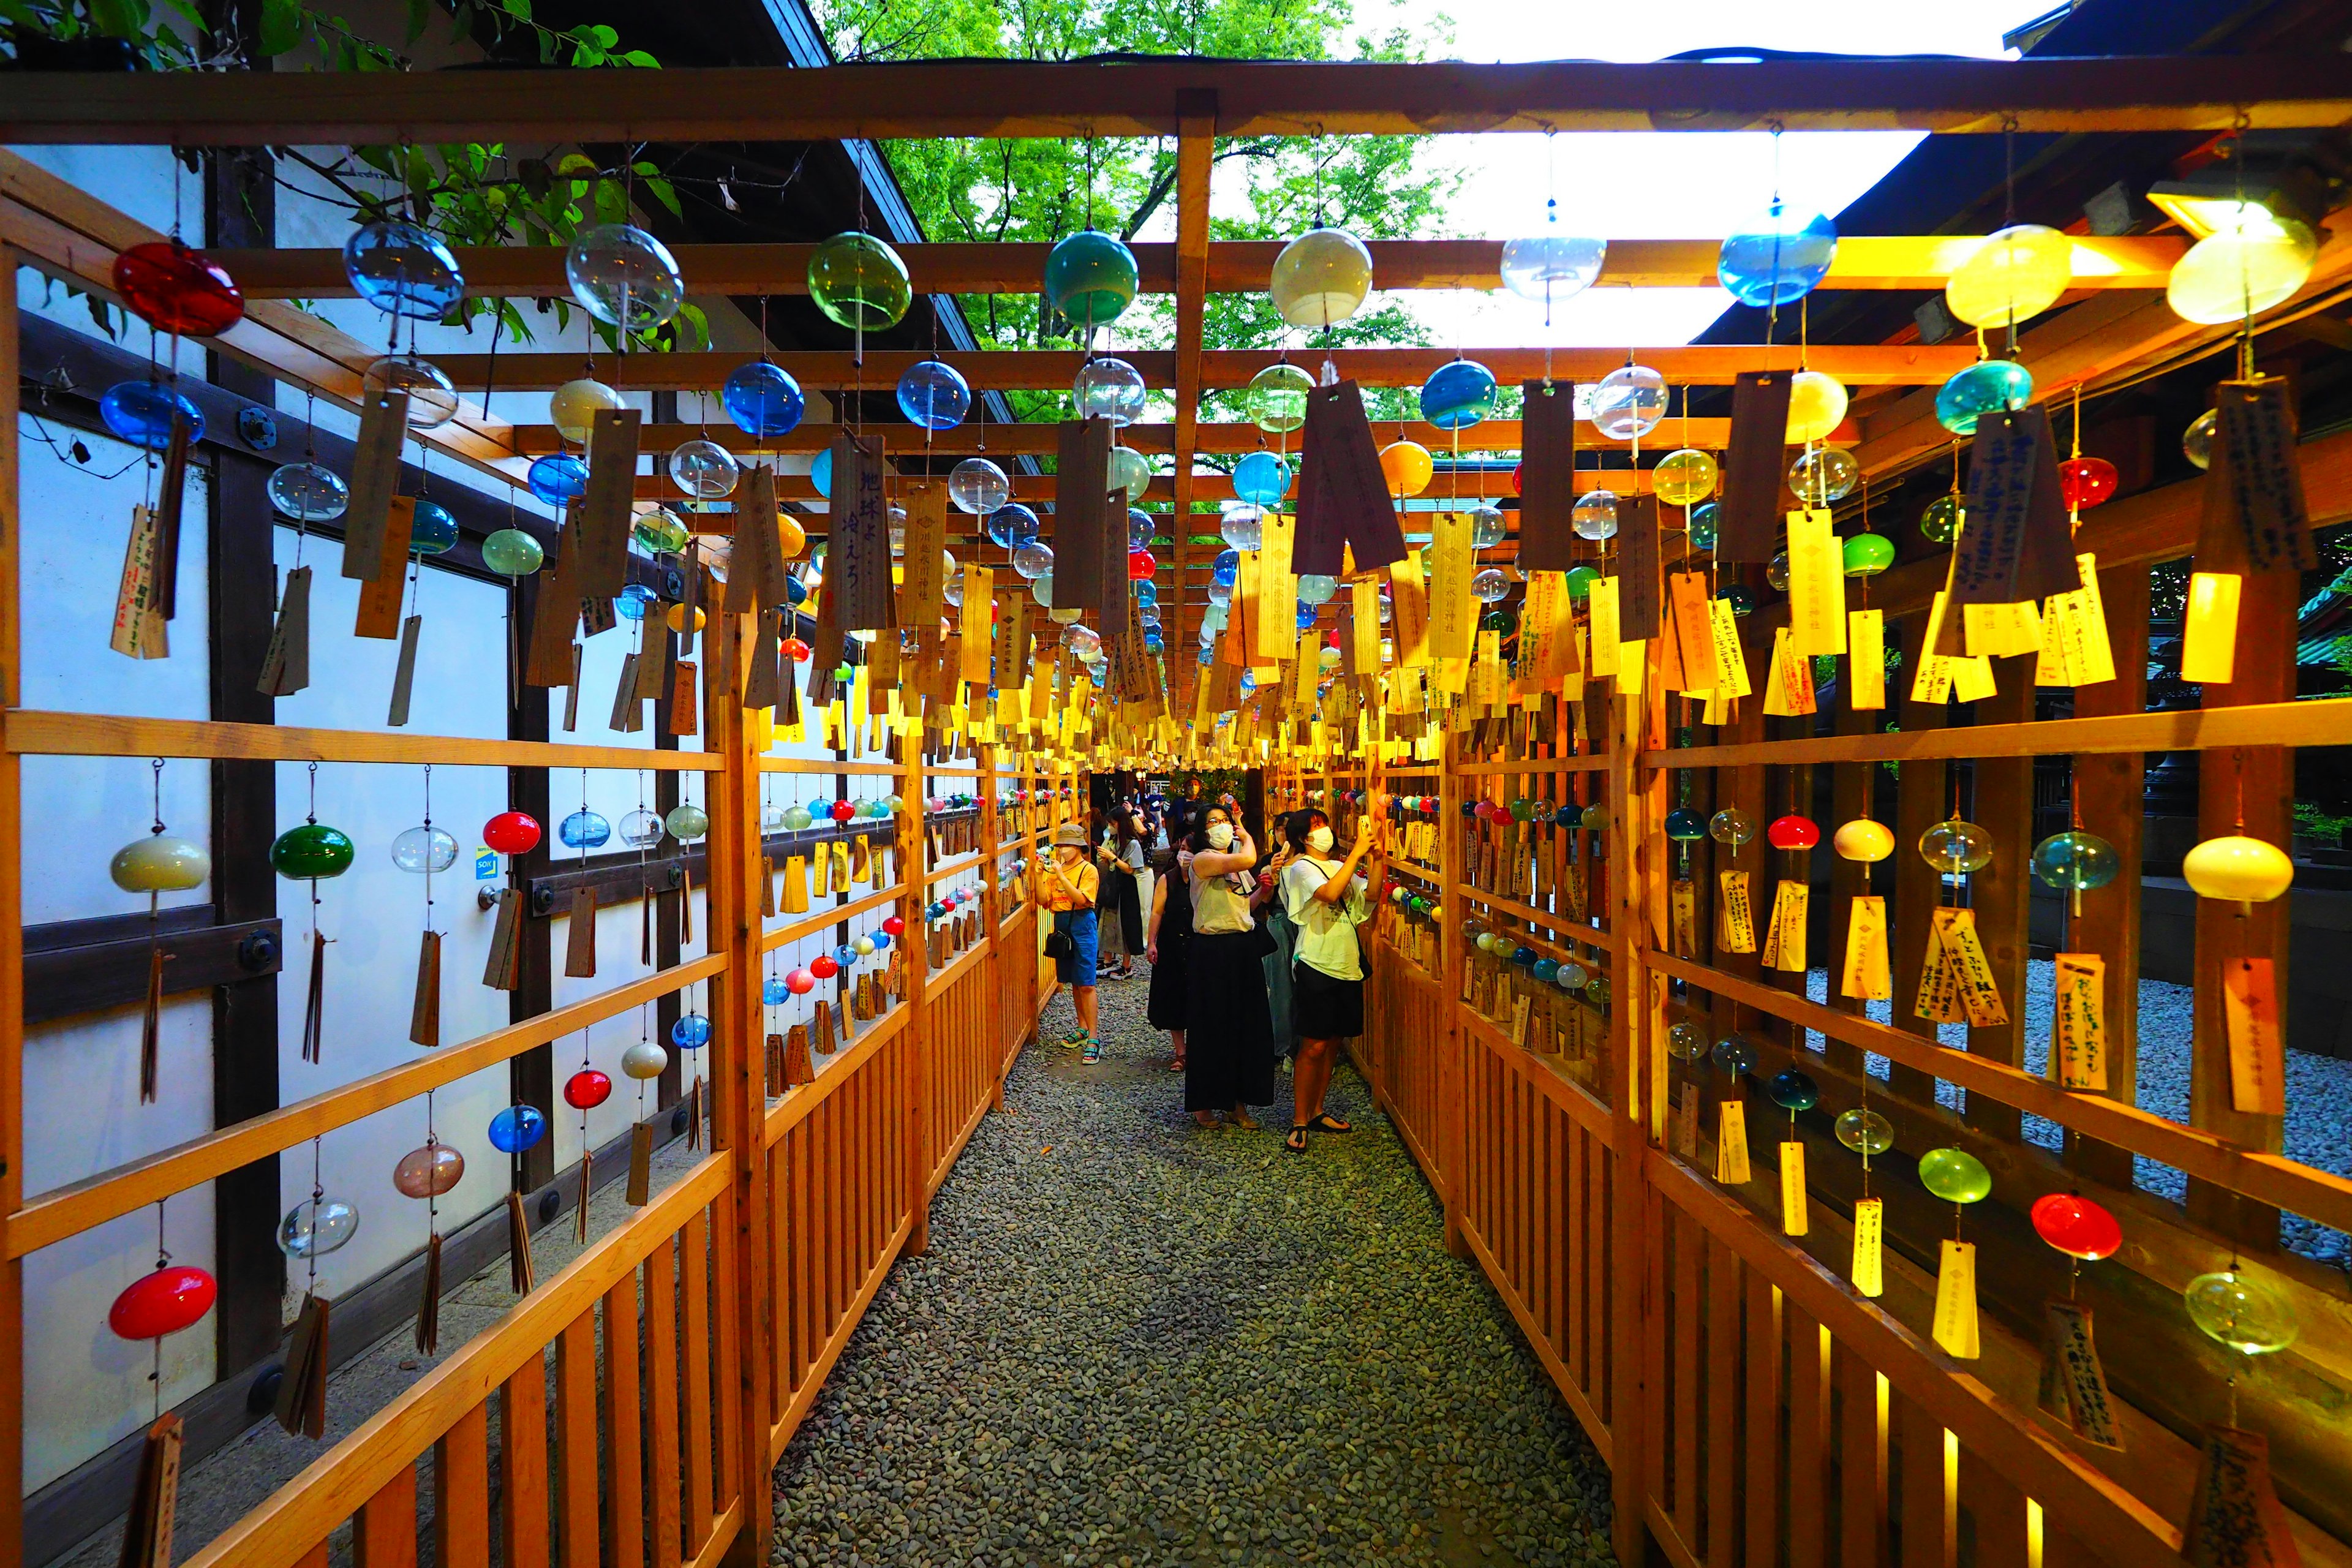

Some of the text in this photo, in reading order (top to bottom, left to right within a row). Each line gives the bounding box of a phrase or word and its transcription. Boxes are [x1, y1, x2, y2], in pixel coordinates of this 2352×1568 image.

[918, 533, 929, 600] 川越氷川神社
[1445, 565, 1458, 634] 川越氷川神社
